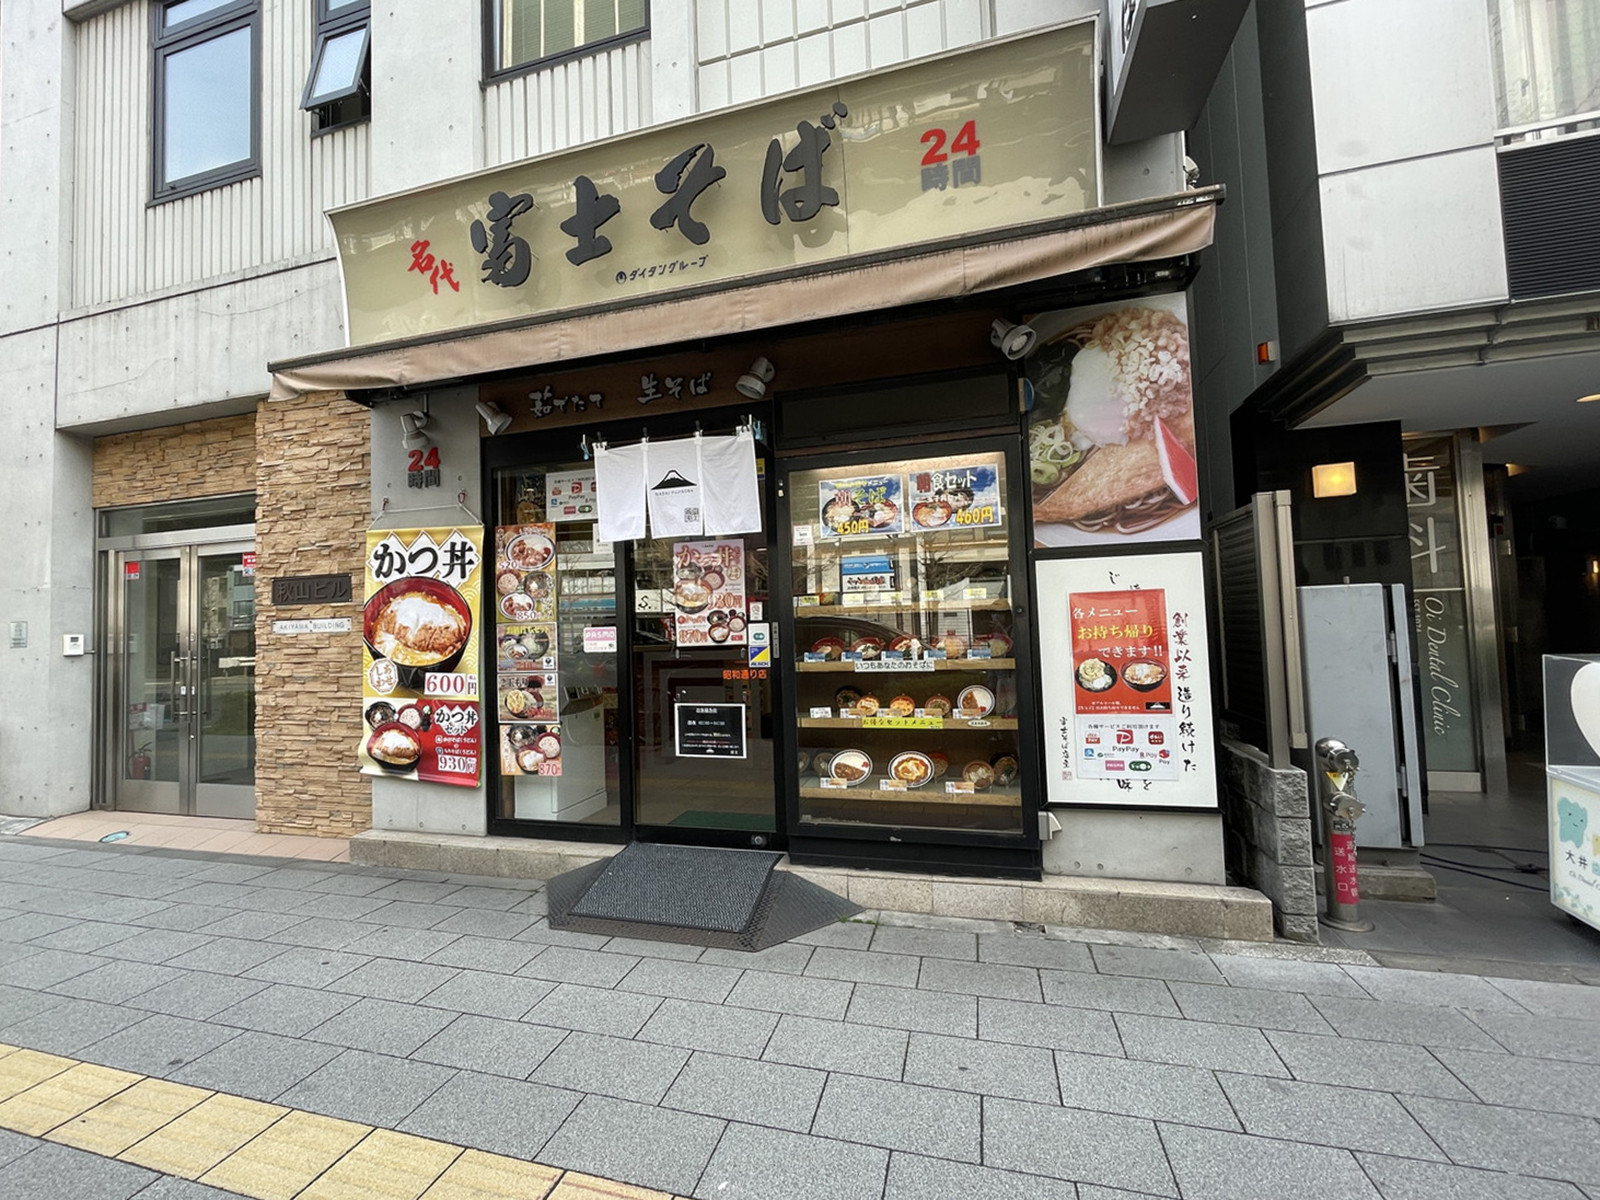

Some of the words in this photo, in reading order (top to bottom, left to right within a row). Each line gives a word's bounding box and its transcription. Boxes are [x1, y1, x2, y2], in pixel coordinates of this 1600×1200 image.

[920, 120, 981, 166] 24
[921, 154, 981, 191] 時間
[470, 101, 848, 287] 富士そば
[407, 239, 460, 295] 名代
[629, 255, 709, 280] ダイタングループ
[637, 372, 712, 404] 生そば
[408, 447, 441, 472] 24
[407, 469, 441, 488] 時間
[837, 518, 869, 534] 450円
[955, 505, 994, 524] 460円
[373, 540, 475, 579] かつ丼
[276, 580, 348, 601] 秋山ビル
[1072, 607, 1138, 620] 各メニュー
[1424, 596, 1445, 620] Oi
[1077, 624, 1154, 640] お持ち帰り
[855, 661, 934, 671] いつもあなたのおそばに
[1427, 626, 1459, 688] Dental
[722, 669, 767, 680] 昭和通り店
[436, 709, 477, 726] かつ丼
[1431, 686, 1461, 736] Clinic
[444, 724, 468, 735] セット
[1335, 846, 1348, 891] 送水口
[1565, 850, 1589, 870] 大井
